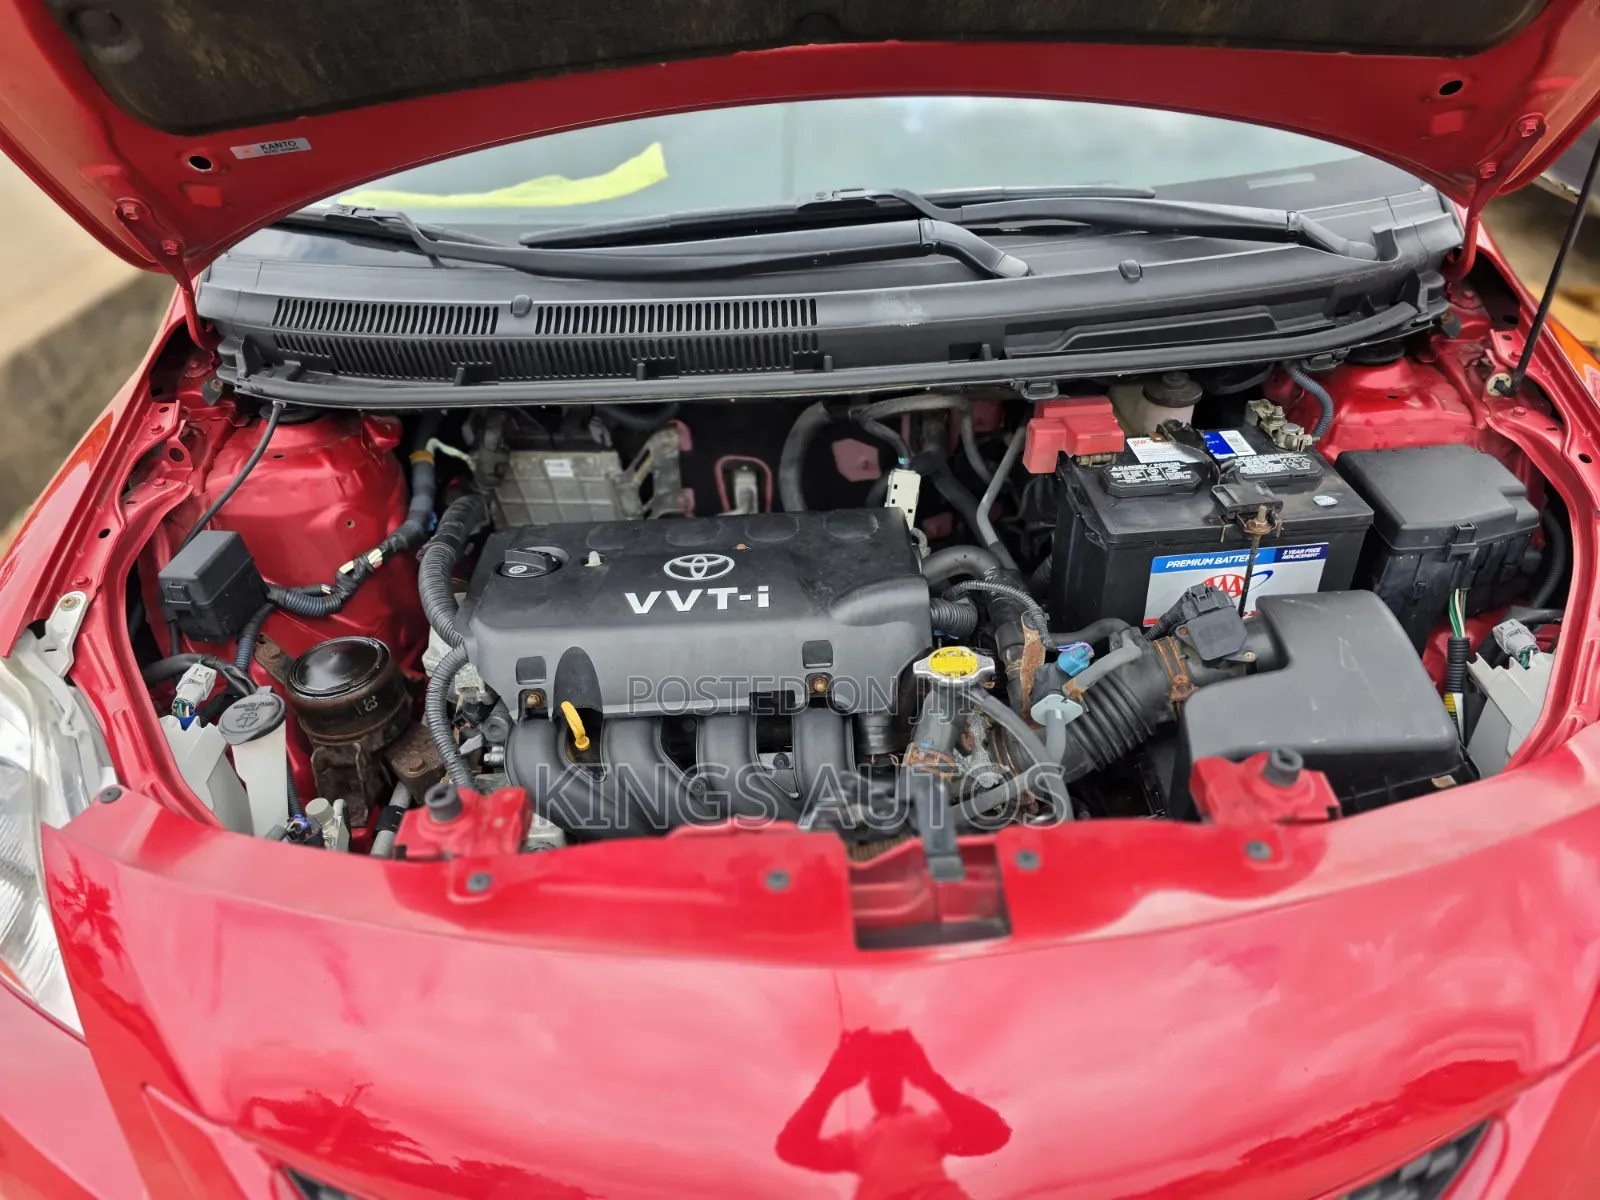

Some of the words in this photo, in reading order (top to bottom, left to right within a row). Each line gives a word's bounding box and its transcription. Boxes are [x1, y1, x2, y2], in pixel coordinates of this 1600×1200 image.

[260, 140, 297, 151] KANTO
[1166, 557, 1214, 568] PREMIUM
[624, 585, 770, 615] VVT-i
